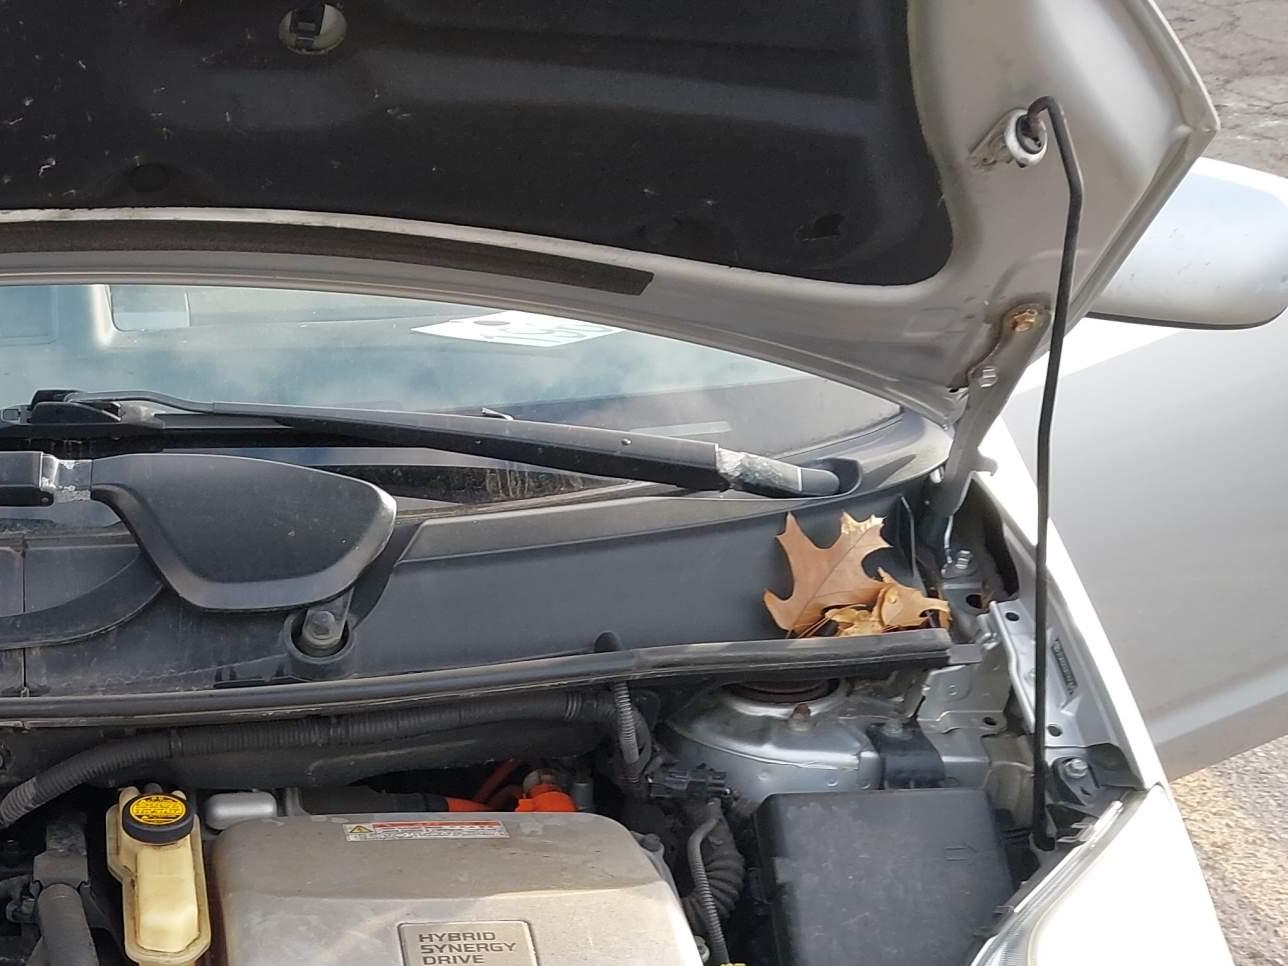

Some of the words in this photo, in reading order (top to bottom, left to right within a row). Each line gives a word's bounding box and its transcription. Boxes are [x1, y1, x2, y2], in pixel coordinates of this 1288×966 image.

[419, 932, 496, 942] HYBRID
[420, 943, 517, 953] SYNERGY
[423, 954, 485, 965] DRIVE
